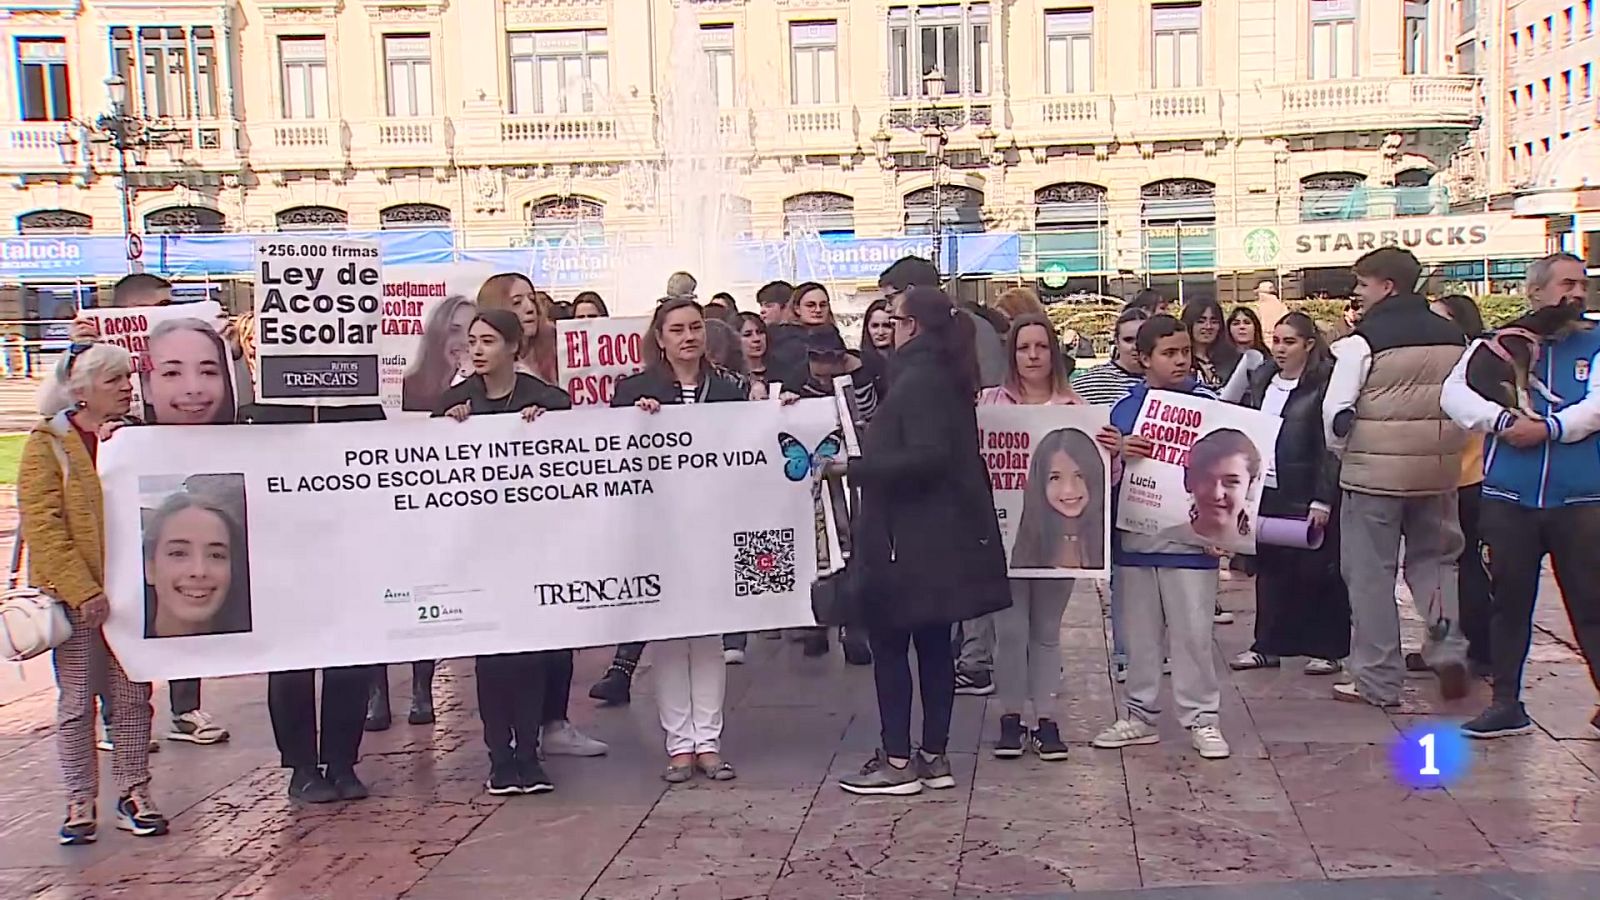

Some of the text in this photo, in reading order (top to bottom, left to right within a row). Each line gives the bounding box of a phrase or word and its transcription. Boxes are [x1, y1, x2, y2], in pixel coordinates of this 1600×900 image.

[259, 244, 379, 257] +256.000 firmas
[1296, 225, 1487, 253] STARBUCKS
[261, 261, 379, 291] Ley de
[260, 288, 379, 314] Acoso
[382, 300, 424, 316] colar
[104, 315, 148, 335] acoso
[260, 317, 378, 345] Escolar
[565, 331, 591, 368] El
[1145, 399, 1202, 428] El acoso
[345, 431, 693, 467] POR UNA LEY INTEGRAL DE ACOSO
[988, 431, 1030, 449] acoso
[267, 449, 768, 493] EL ACOSO ESCOLAR DEJA SECUELAS DE POR VIDA
[991, 473, 1028, 490] ATA
[394, 479, 654, 511] EL ACOSO ESCOLAR MATA
[534, 574, 661, 606] TRENCATS
[418, 605, 440, 620] 20
